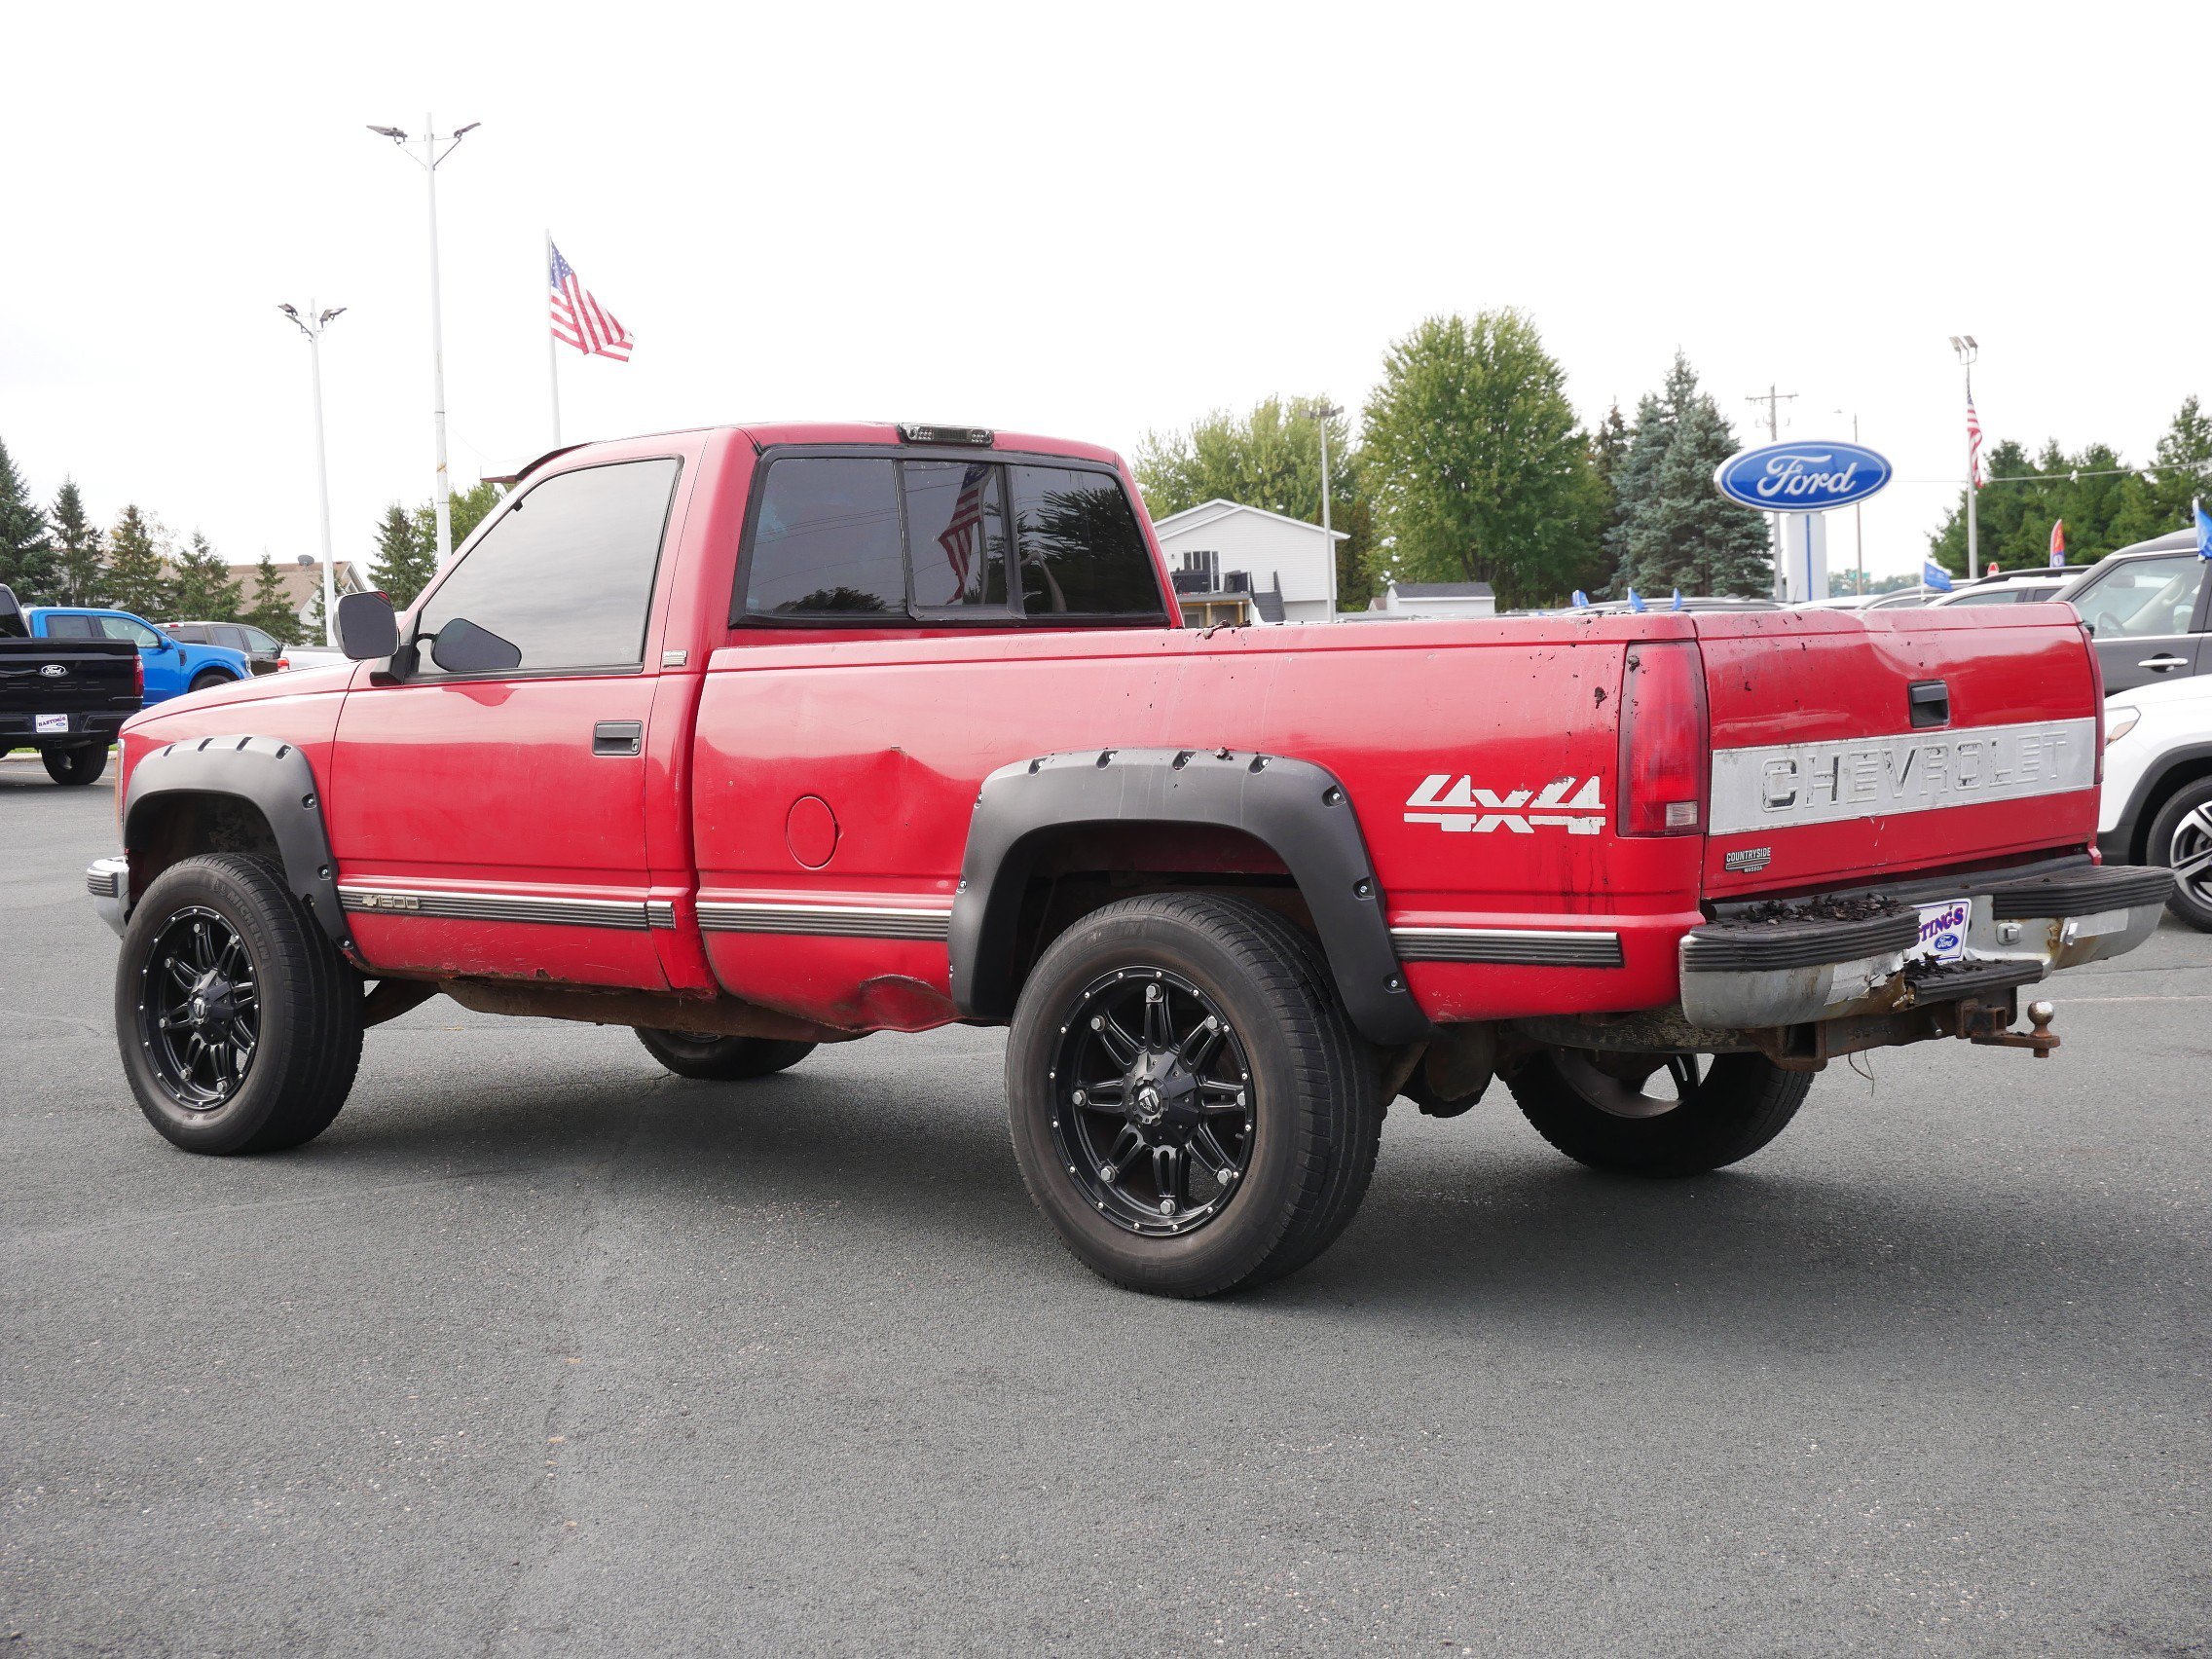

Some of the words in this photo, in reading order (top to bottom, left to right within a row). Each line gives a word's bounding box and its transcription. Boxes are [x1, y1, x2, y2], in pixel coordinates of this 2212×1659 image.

[1756, 454, 1858, 497] Ford
[1761, 731, 2068, 813] CHEVROLET
[1726, 847, 1771, 863] COUNTRYSIDE
[225, 890, 271, 961] MICHELIN
[1937, 935, 1954, 949] Ford
